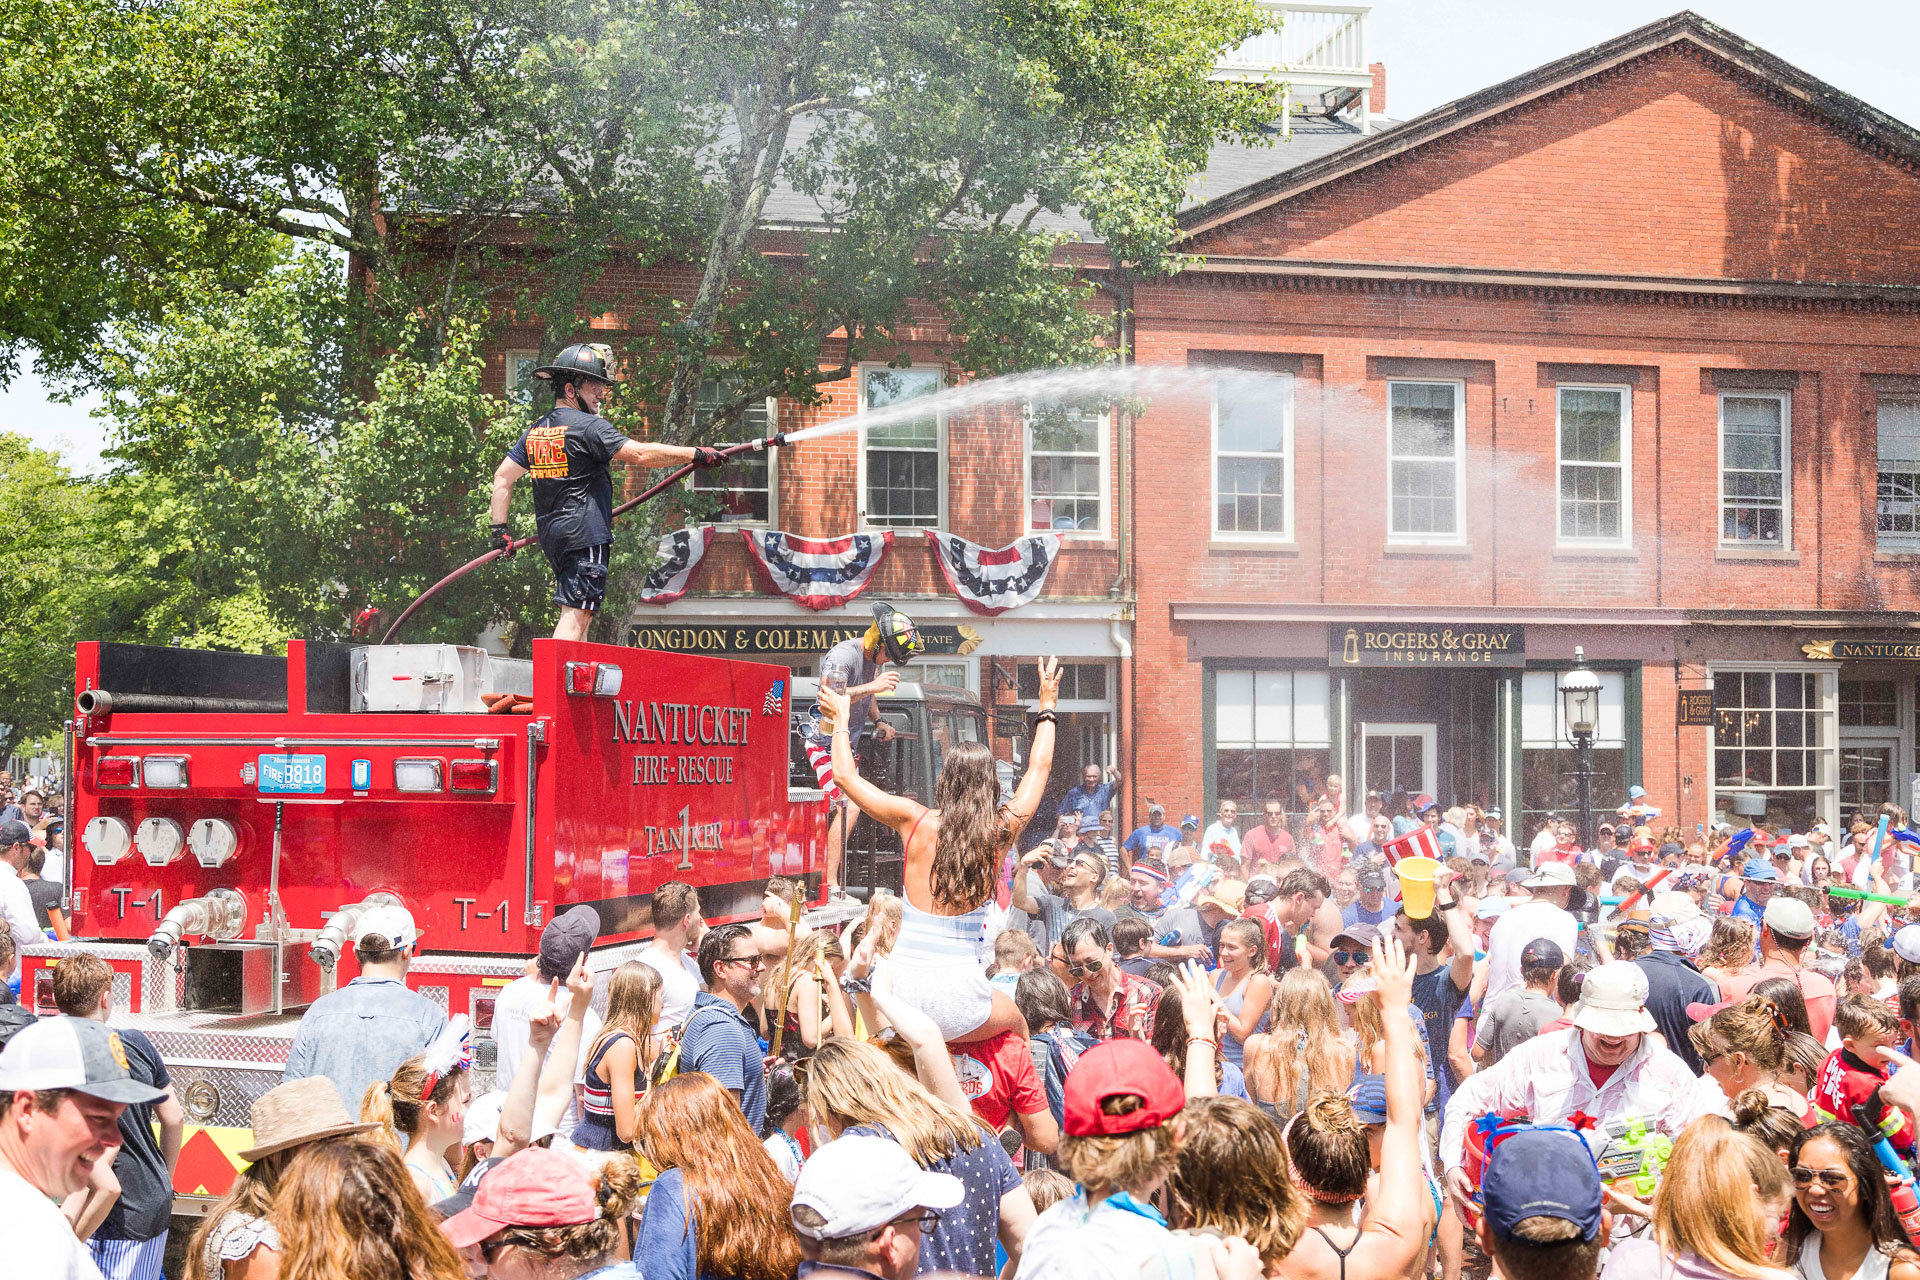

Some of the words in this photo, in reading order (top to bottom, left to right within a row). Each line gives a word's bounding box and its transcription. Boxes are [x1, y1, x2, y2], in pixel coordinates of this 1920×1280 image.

[526, 439, 568, 466] FIRE
[626, 630, 728, 649] CONGDON
[735, 630, 750, 649] &
[1364, 632, 1438, 649] ROGERS
[1441, 629, 1460, 650] &
[1462, 633, 1512, 650] GRAY
[1385, 651, 1492, 662] INSURANCE
[1689, 695, 1712, 705] ROGERS
[1696, 706, 1711, 716] GRAY
[611, 699, 752, 747] NANTUCKET
[263, 764, 284, 784] FIRE
[284, 764, 322, 785] B818
[632, 755, 734, 786] FIRE-RESCUE
[111, 887, 163, 920] T-1
[452, 897, 510, 932] T-1
